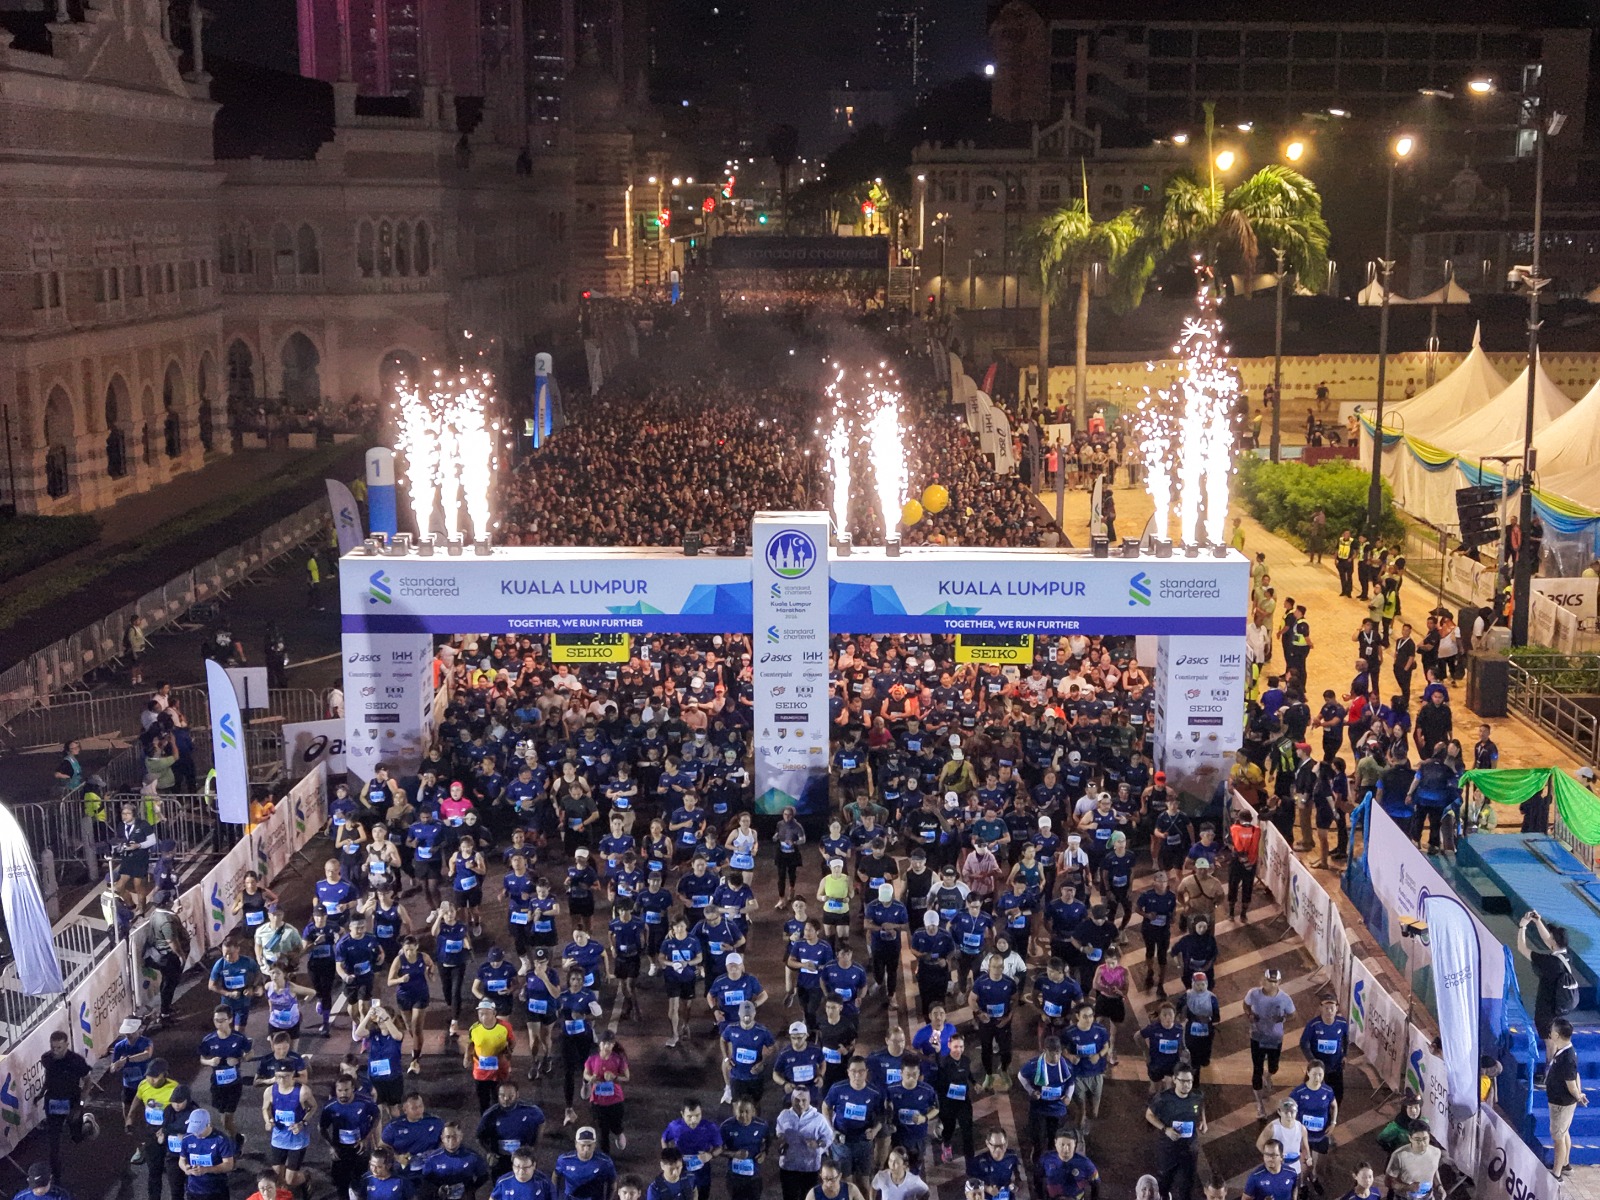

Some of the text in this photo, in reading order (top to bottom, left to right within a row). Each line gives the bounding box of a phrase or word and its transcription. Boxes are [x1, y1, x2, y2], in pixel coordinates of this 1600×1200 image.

[371, 459, 380, 477] 1
[400, 576, 456, 588] standard
[500, 579, 648, 596] KUALA LUMPUR
[1159, 578, 1217, 588] standard
[400, 586, 460, 598] chartered
[938, 580, 1086, 597] KUALA LUMPUR
[1159, 587, 1220, 599] chartered
[508, 618, 644, 629] TOGETHER, WE RUN FURTHER
[944, 620, 1080, 631] TOGETHER, WE RUN FURTHER
[360, 654, 382, 662] asics
[392, 651, 412, 660] IHH
[566, 648, 612, 658] SEIKO
[803, 652, 823, 660] IHH
[970, 648, 1018, 659] SEIKO
[1220, 654, 1240, 663] IHH
